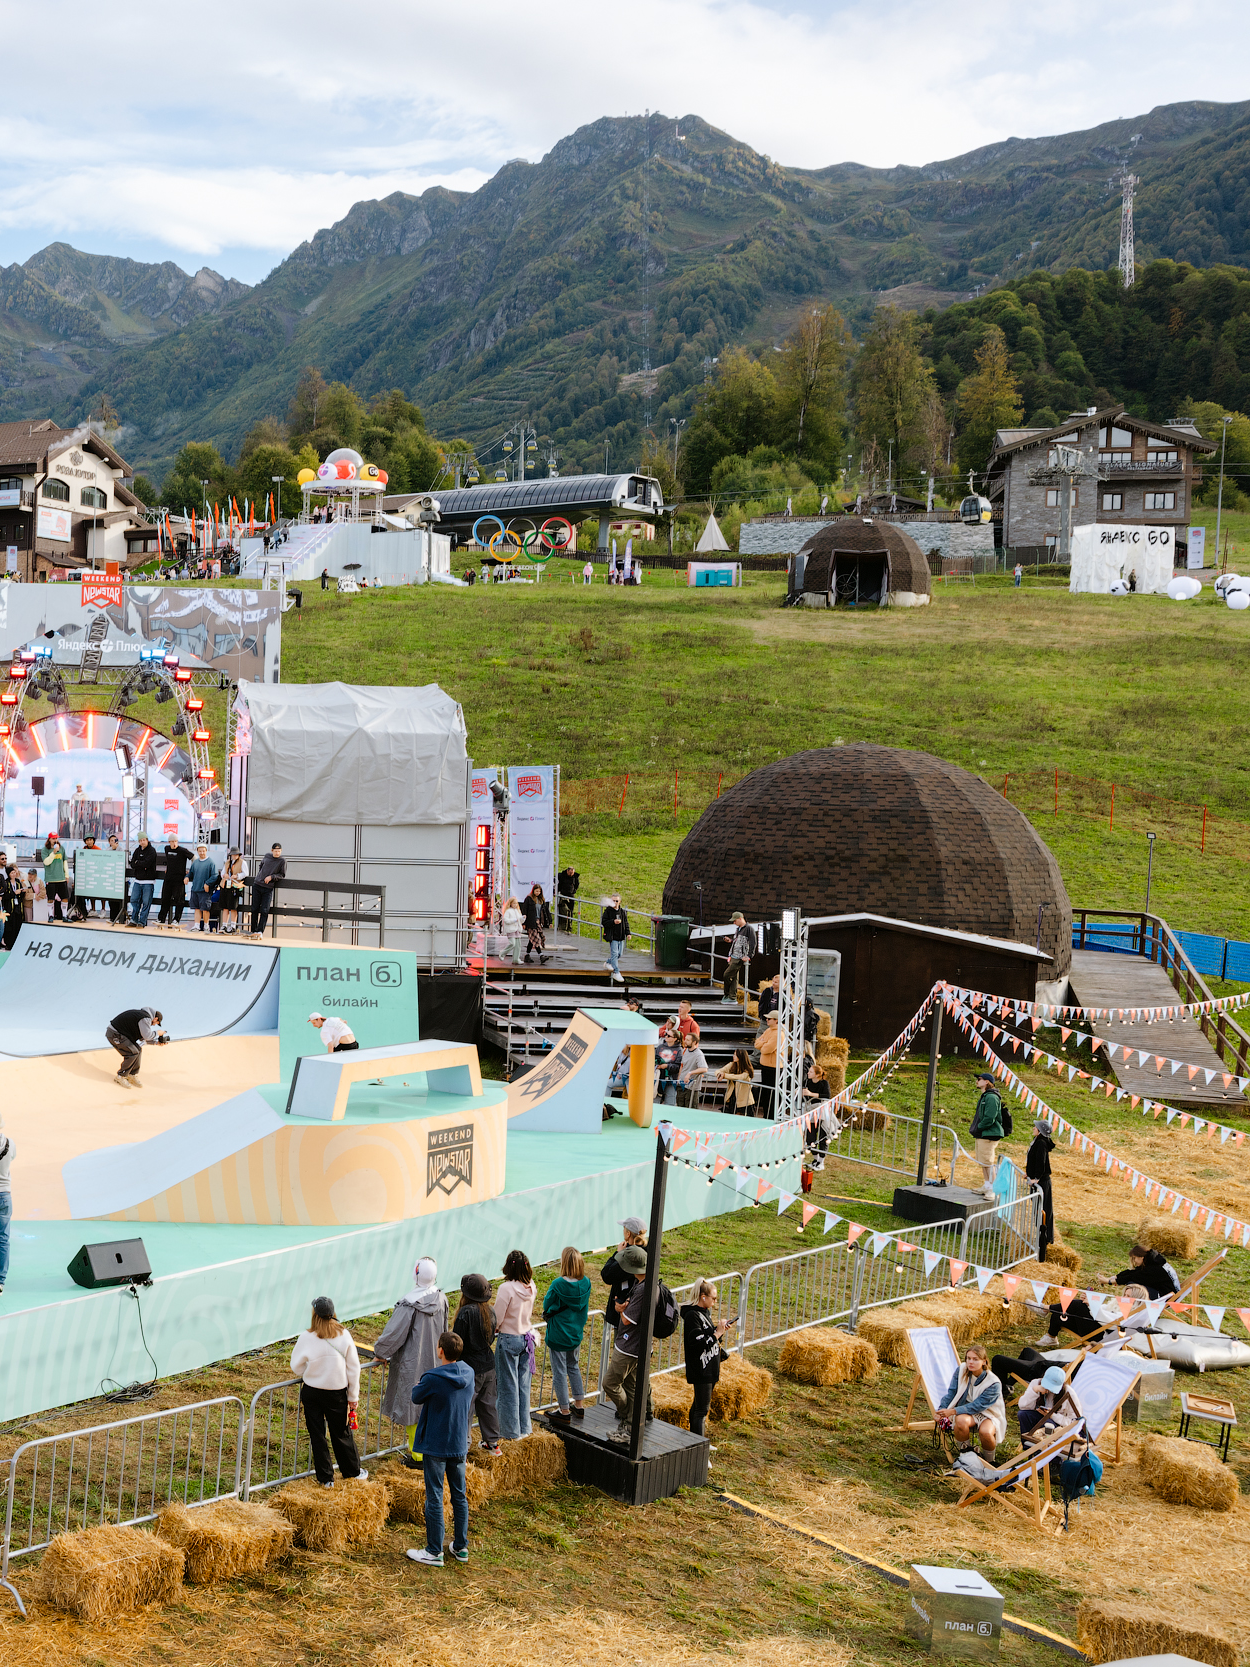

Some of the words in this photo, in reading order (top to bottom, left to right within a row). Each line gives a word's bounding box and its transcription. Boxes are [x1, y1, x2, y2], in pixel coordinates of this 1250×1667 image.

[369, 467, 379, 476] Go
[1147, 530, 1171, 545] GO
[83, 575, 121, 583] WEEKEND
[83, 586, 121, 604] NEWSTAR
[57, 638, 100, 652] Яндекс
[115, 640, 147, 652] Плюс
[24, 941, 53, 959] на
[57, 944, 137, 969] одном
[136, 953, 252, 982] дыхании
[296, 966, 361, 982] план
[375, 964, 398, 984] б.
[322, 994, 379, 1008] билайн
[430, 1127, 472, 1146] WEEKEND
[428, 1148, 471, 1189] NEWSTAR
[1144, 1391, 1168, 1402] билайн
[911, 1596, 930, 1625] билайн
[944, 1621, 974, 1632] план
[978, 1623, 990, 1634] б.
